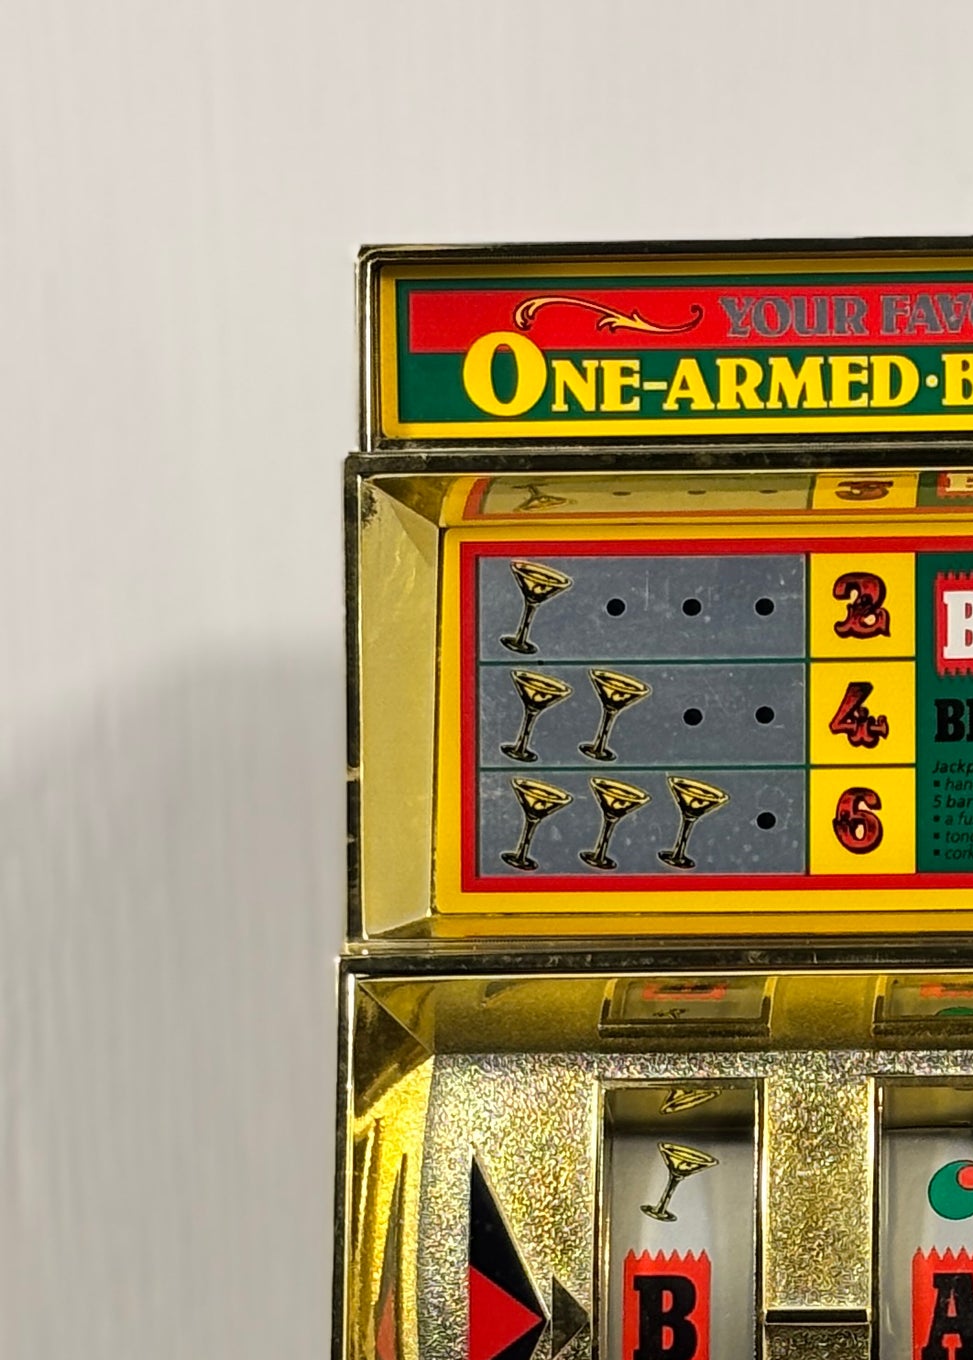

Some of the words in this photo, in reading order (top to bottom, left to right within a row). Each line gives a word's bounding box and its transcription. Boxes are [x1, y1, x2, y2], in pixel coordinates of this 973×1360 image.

[719, 295, 870, 338] YOUR
[832, 571, 891, 639] 2
[829, 681, 889, 749] 4
[832, 787, 884, 854] 6
[932, 795, 942, 808] 5
[946, 795, 972, 808] bar
[944, 814, 953, 826] a
